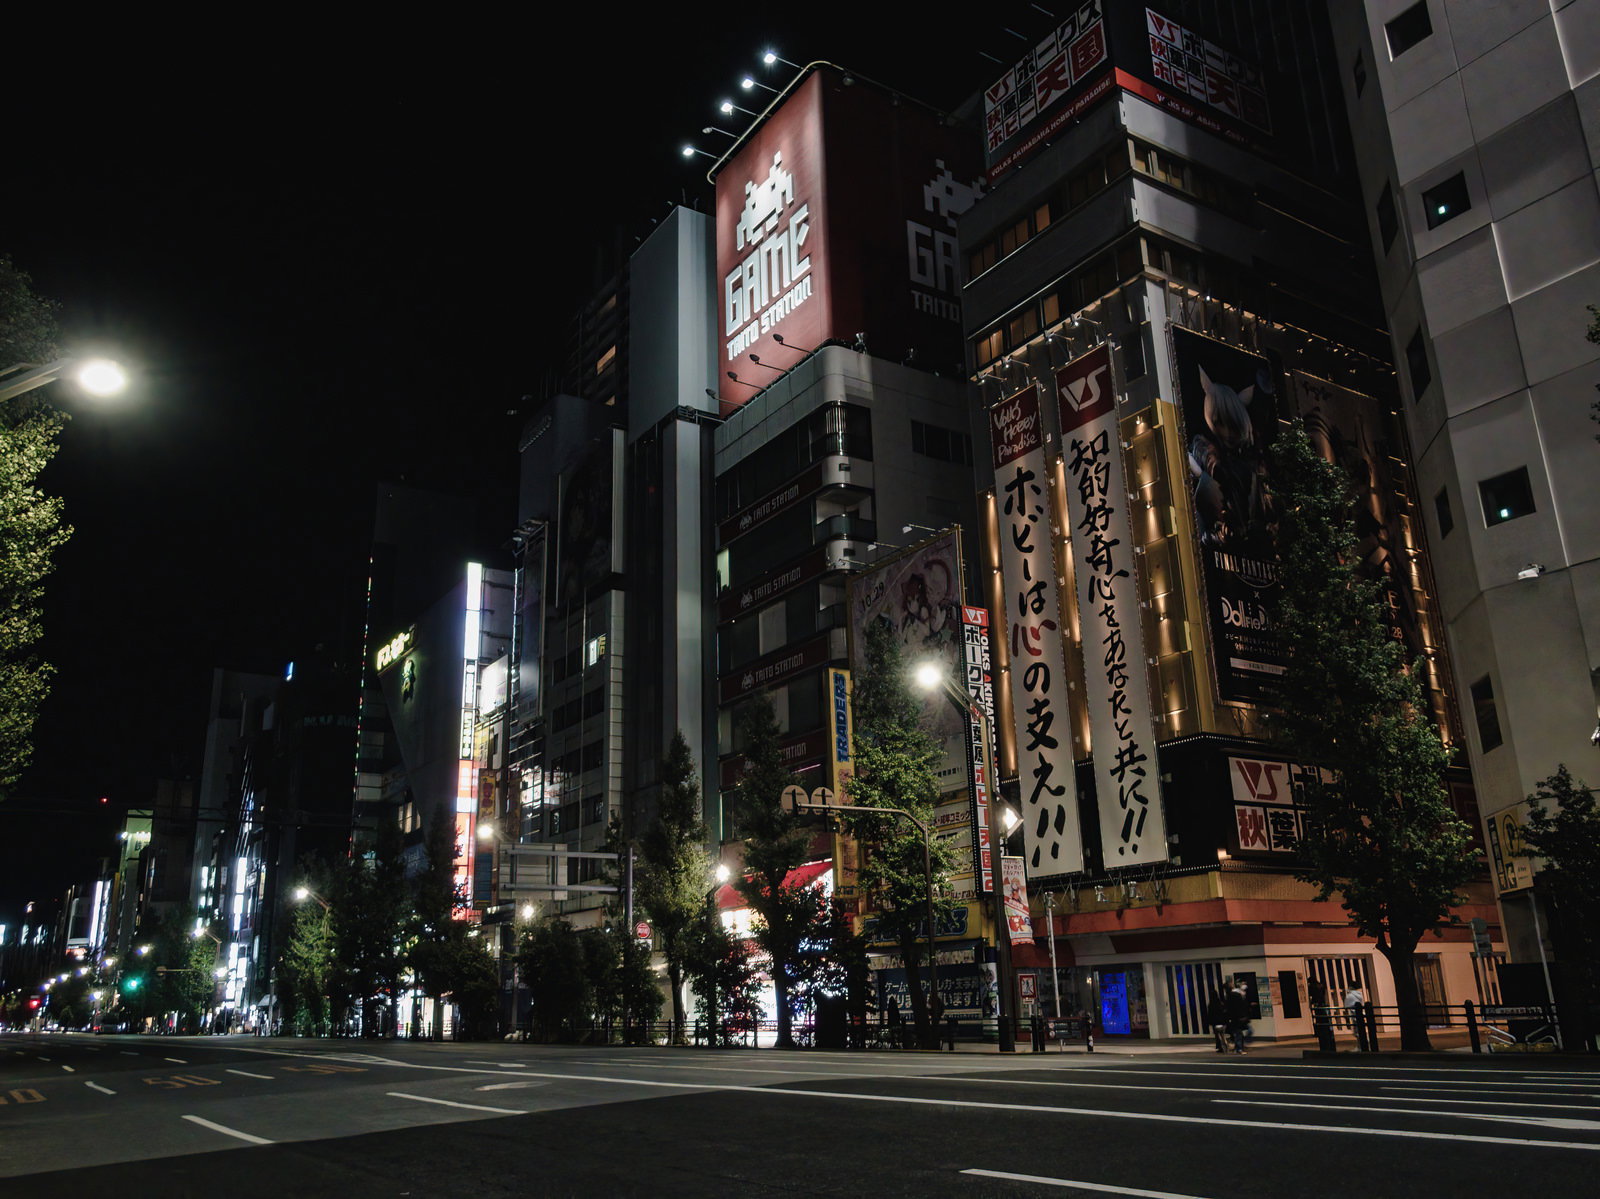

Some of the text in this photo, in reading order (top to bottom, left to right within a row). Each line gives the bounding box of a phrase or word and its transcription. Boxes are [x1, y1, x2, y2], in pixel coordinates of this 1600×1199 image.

[1051, 106, 1075, 130] HOBBY
[1075, 77, 1112, 112] PARADISE
[725, 203, 811, 338] GAME
[727, 272, 813, 361] TAITO STATION
[910, 289, 960, 324] TAITO
[753, 483, 799, 521] TAITO STATION
[754, 565, 801, 602] TAITO STATION
[755, 652, 804, 683] TAITO STATION
[980, 627, 991, 671] VOLKS
[833, 671, 849, 763] TRADERS
[142, 1075, 223, 1090] 50
